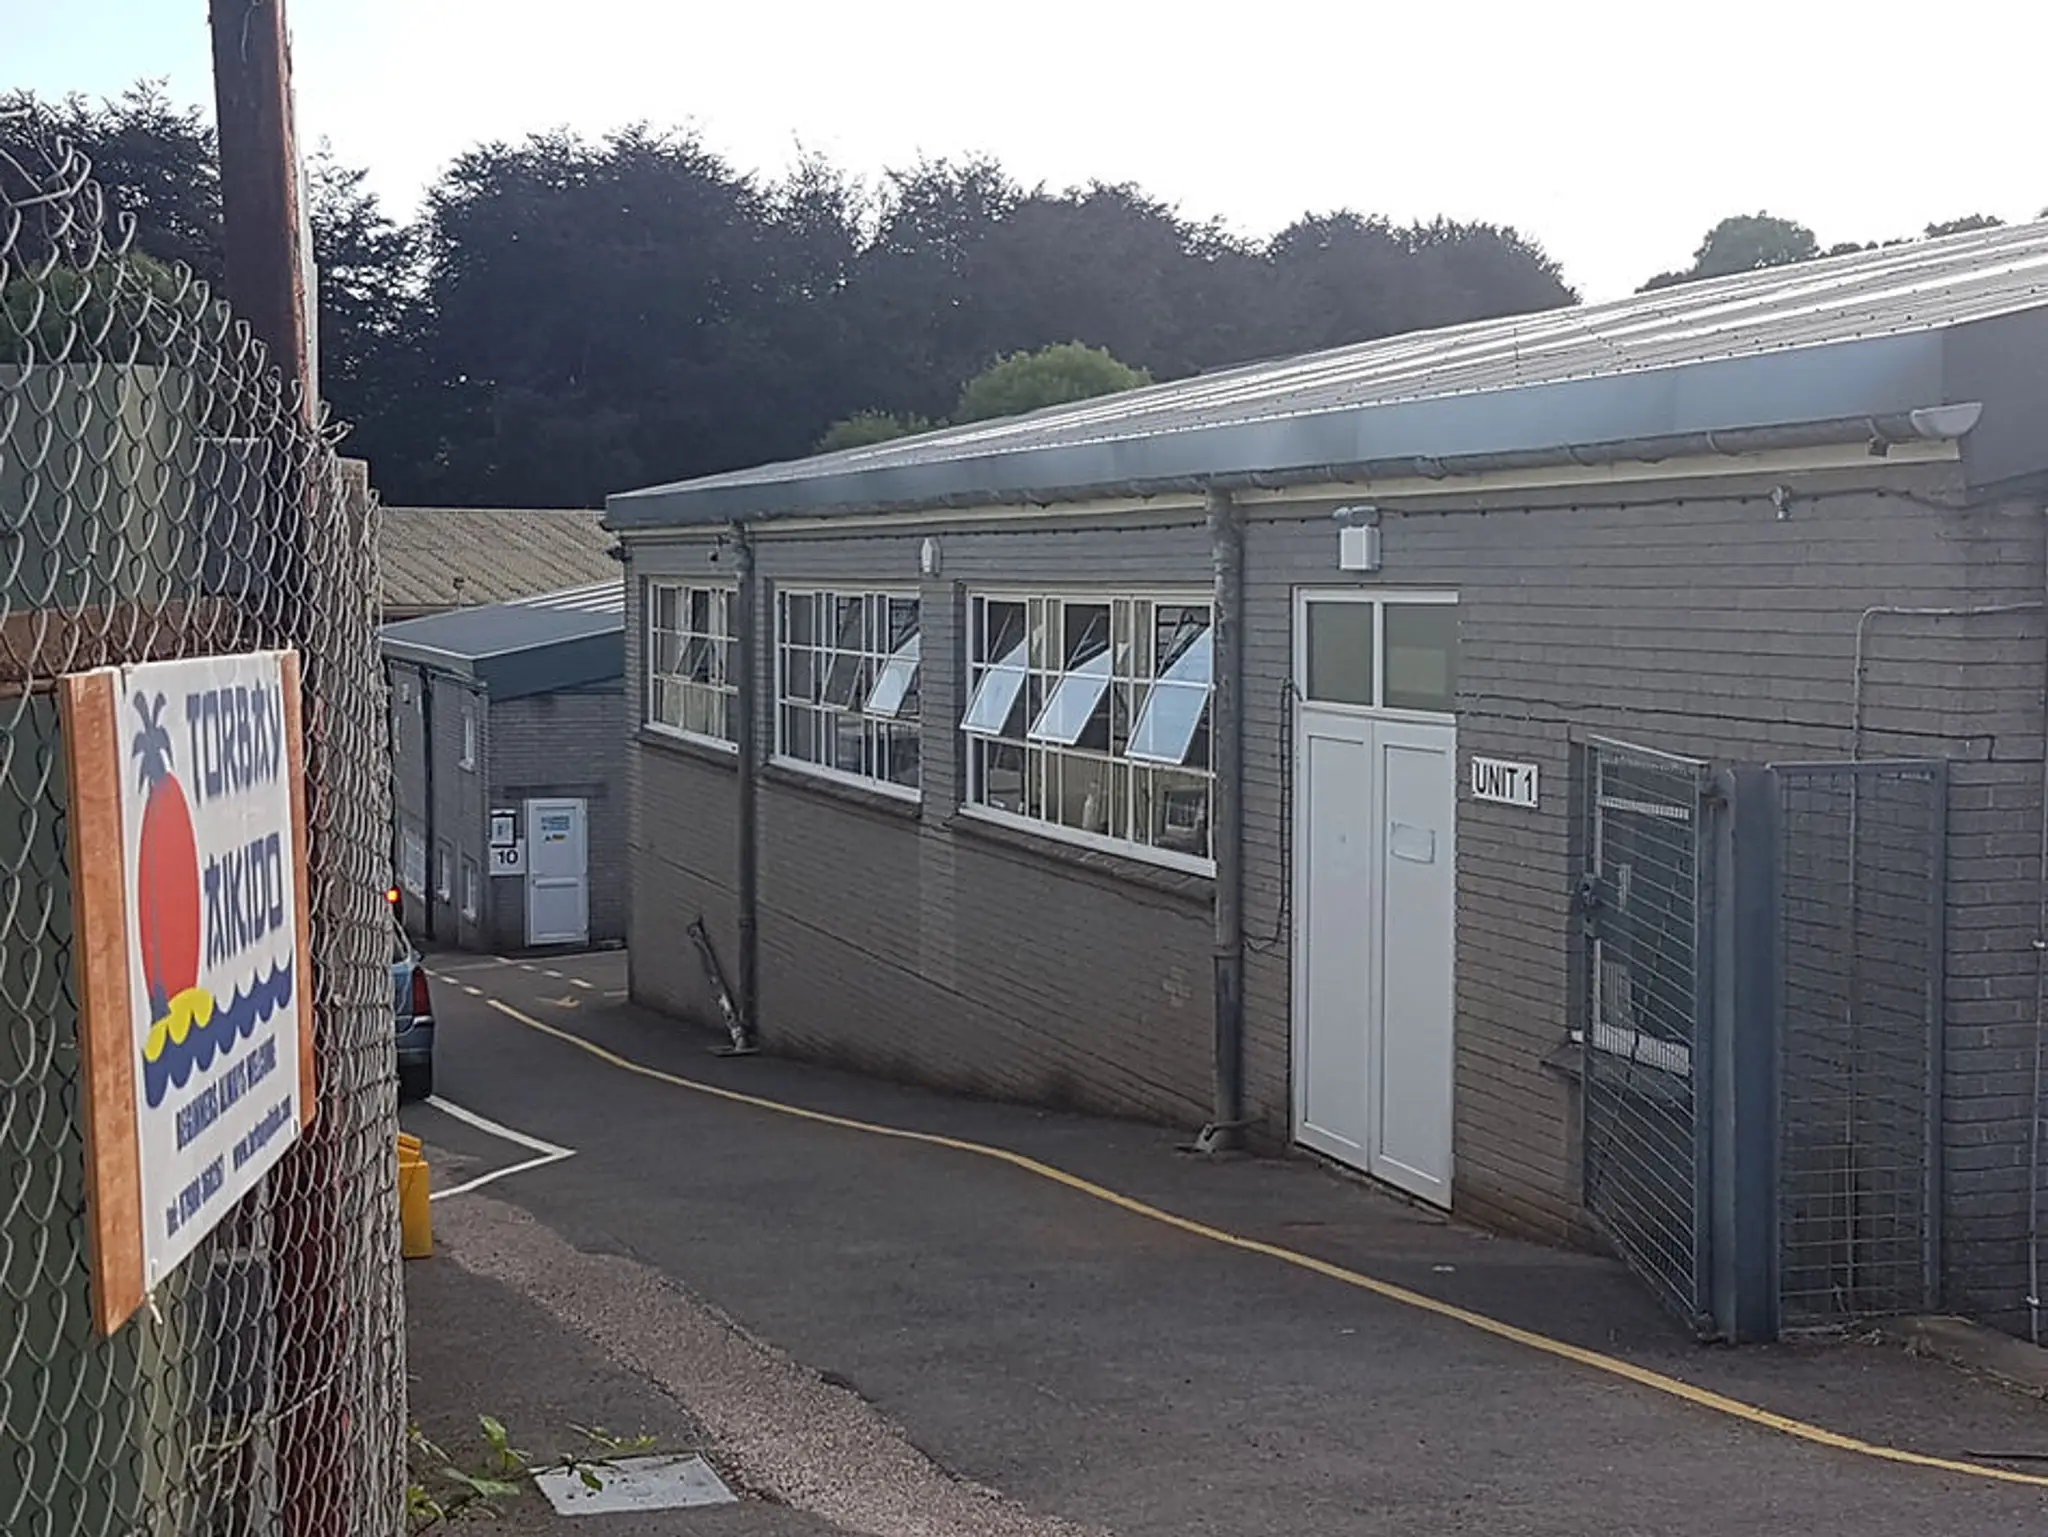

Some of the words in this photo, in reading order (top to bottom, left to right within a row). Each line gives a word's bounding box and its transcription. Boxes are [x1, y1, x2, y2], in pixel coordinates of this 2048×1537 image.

[186, 678, 282, 808] TORBAY
[1476, 763, 1518, 799] UNIT
[1524, 769, 1533, 802] 1
[498, 850, 519, 865] 10
[204, 832, 284, 972] AIKIDO
